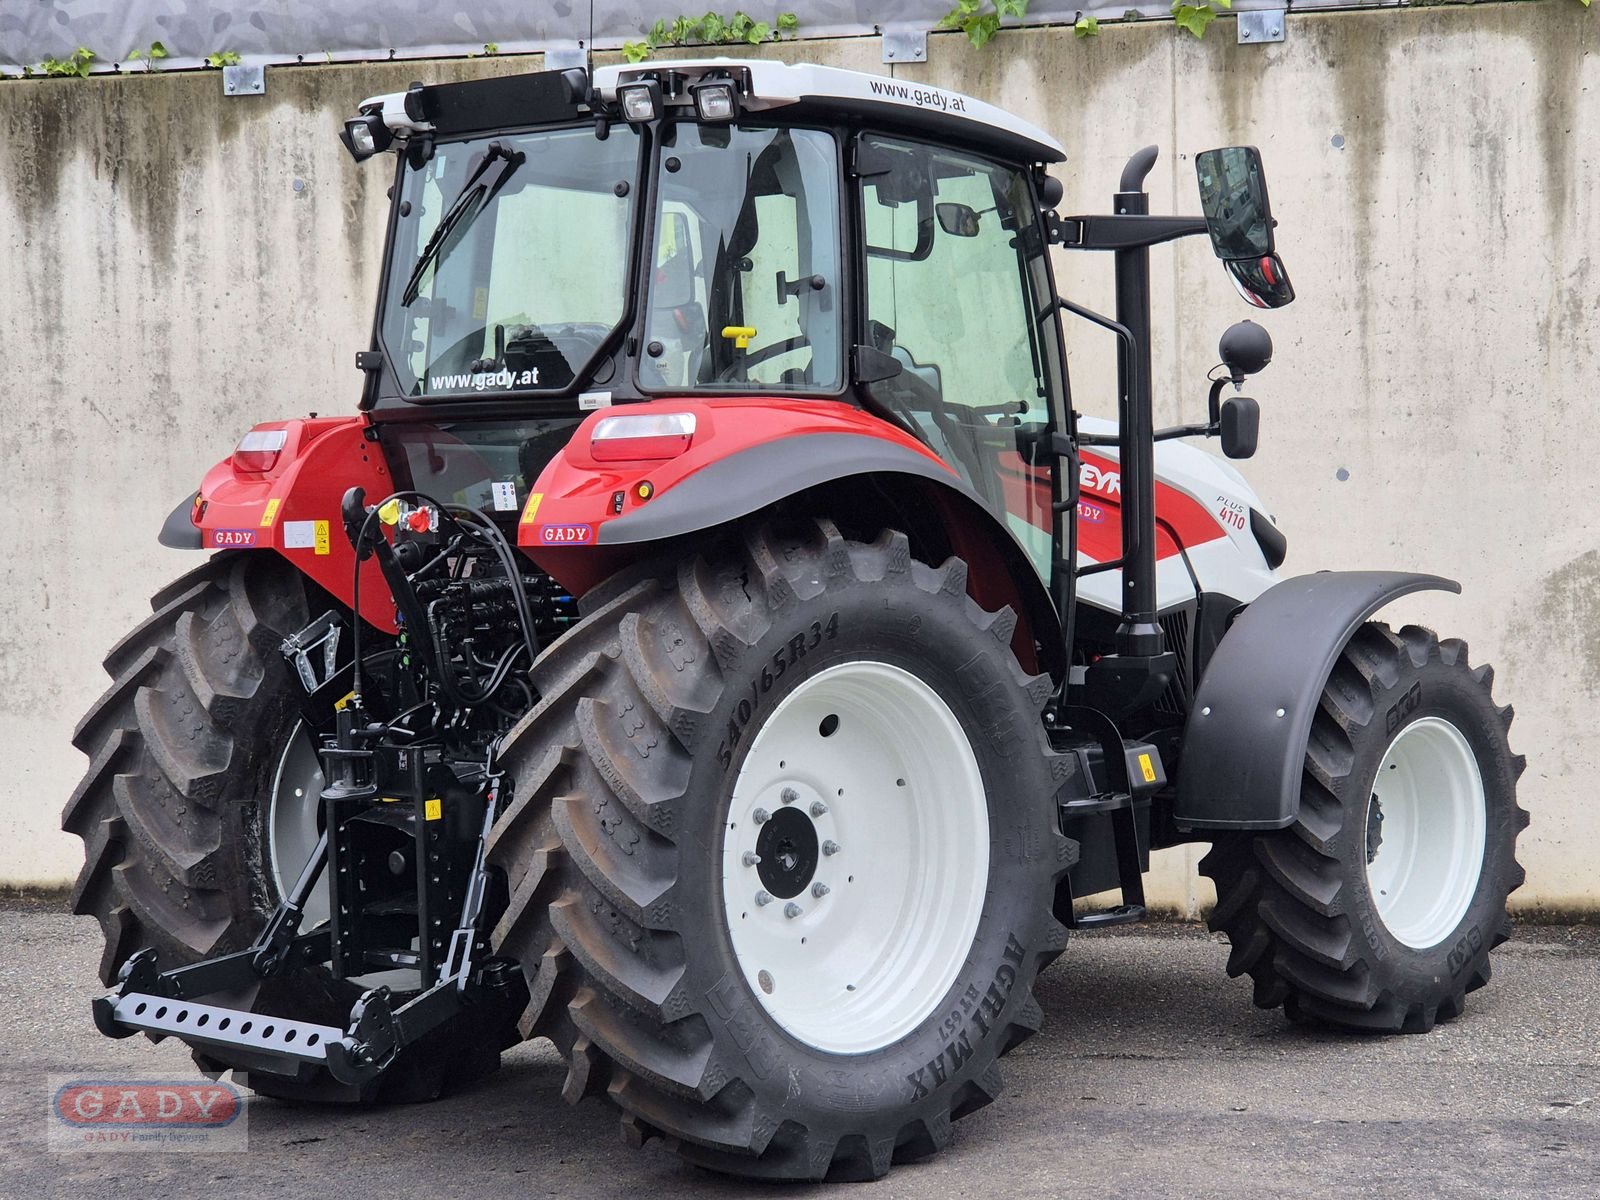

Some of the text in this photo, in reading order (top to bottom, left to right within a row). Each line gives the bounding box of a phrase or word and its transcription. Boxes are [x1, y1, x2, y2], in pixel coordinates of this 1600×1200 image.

[869, 80, 966, 112] www.gady.at
[431, 366, 540, 391] www.gady.at
[1080, 463, 1121, 496] EYR
[1077, 503, 1101, 520] ADY
[1216, 495, 1245, 513] PLUS
[1219, 507, 1246, 530] 4110
[215, 532, 252, 544] GADY
[545, 528, 587, 541] GADY
[716, 610, 840, 773] 540/65R34
[971, 931, 1026, 1039] AGRI
[906, 1028, 974, 1103] MAX
